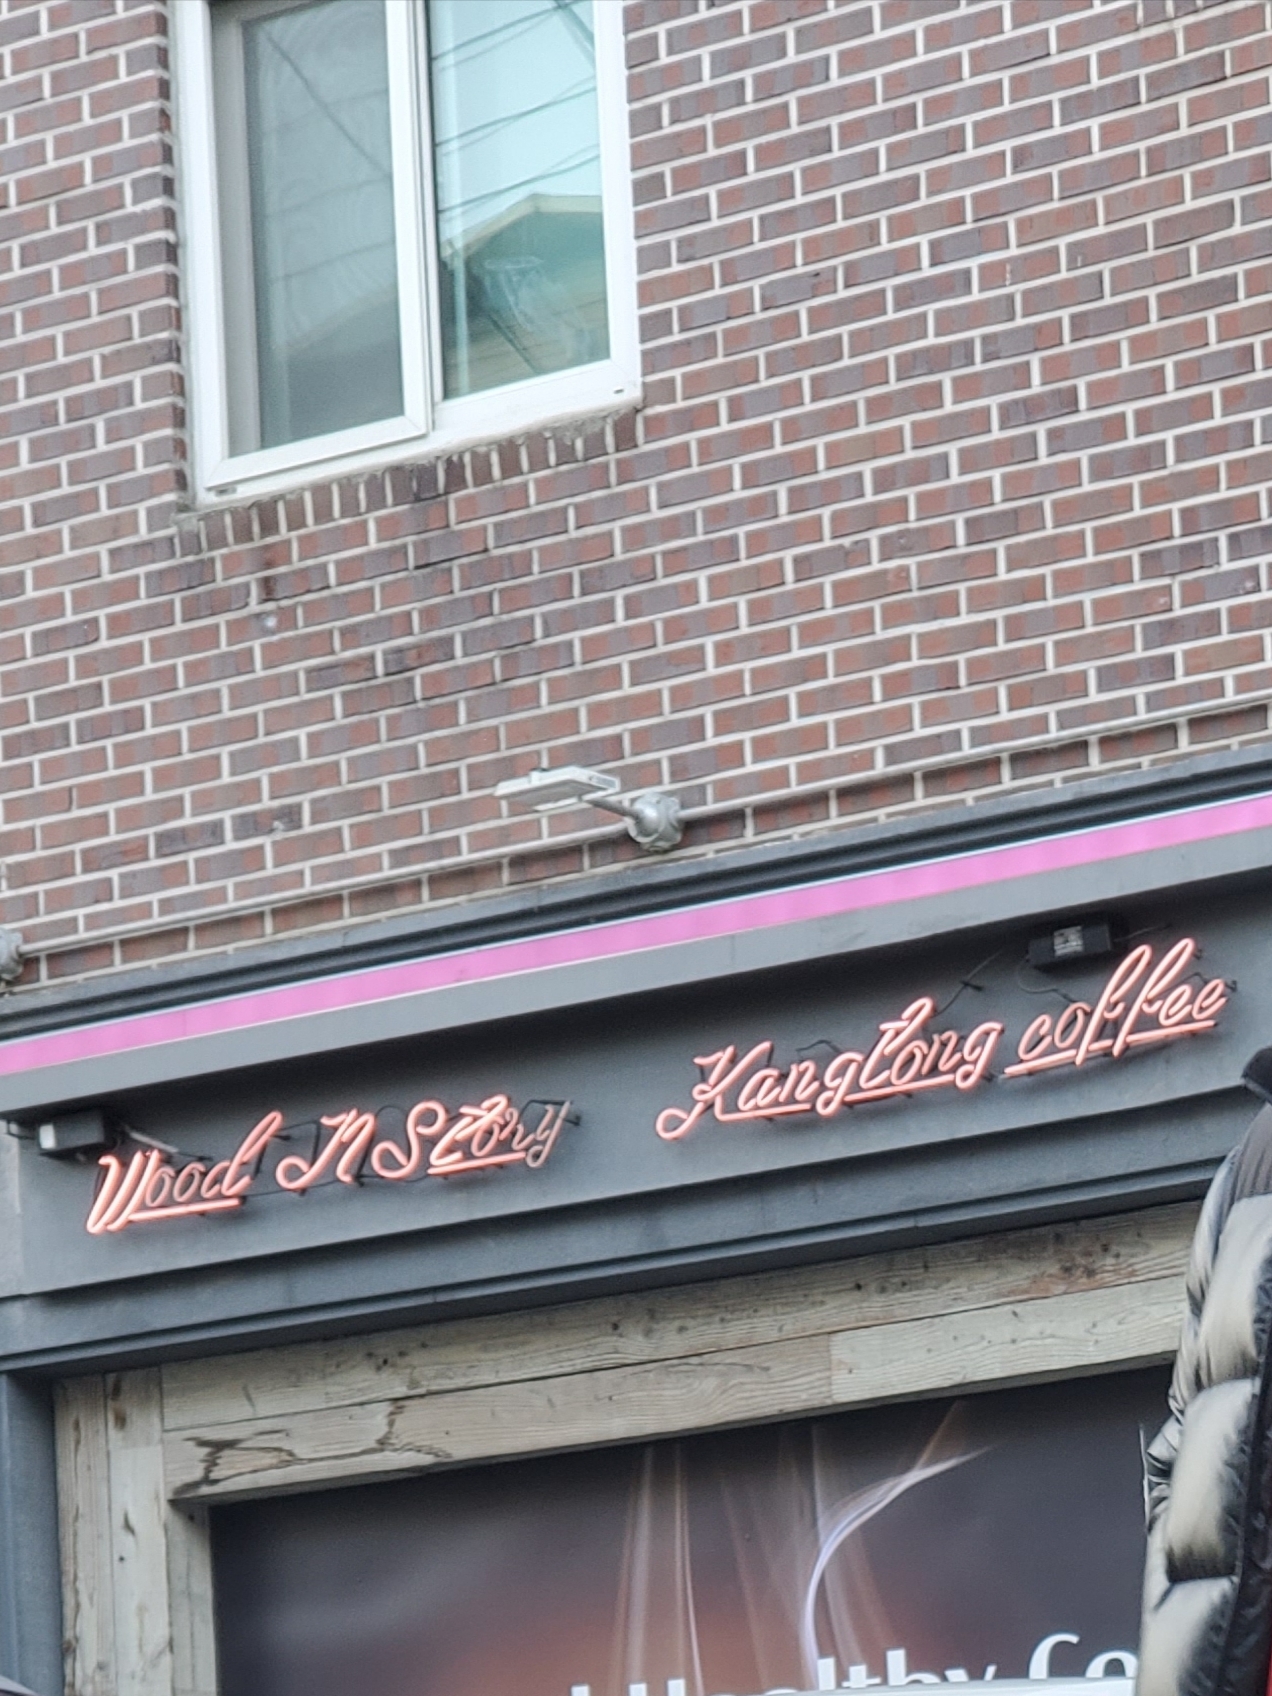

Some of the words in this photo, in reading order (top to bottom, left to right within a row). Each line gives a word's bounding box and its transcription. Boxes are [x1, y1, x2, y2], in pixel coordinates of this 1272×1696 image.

[1002, 938, 1228, 1076] coffee
[86, 1110, 284, 1235] Wood
[371, 1094, 571, 1179] Story
